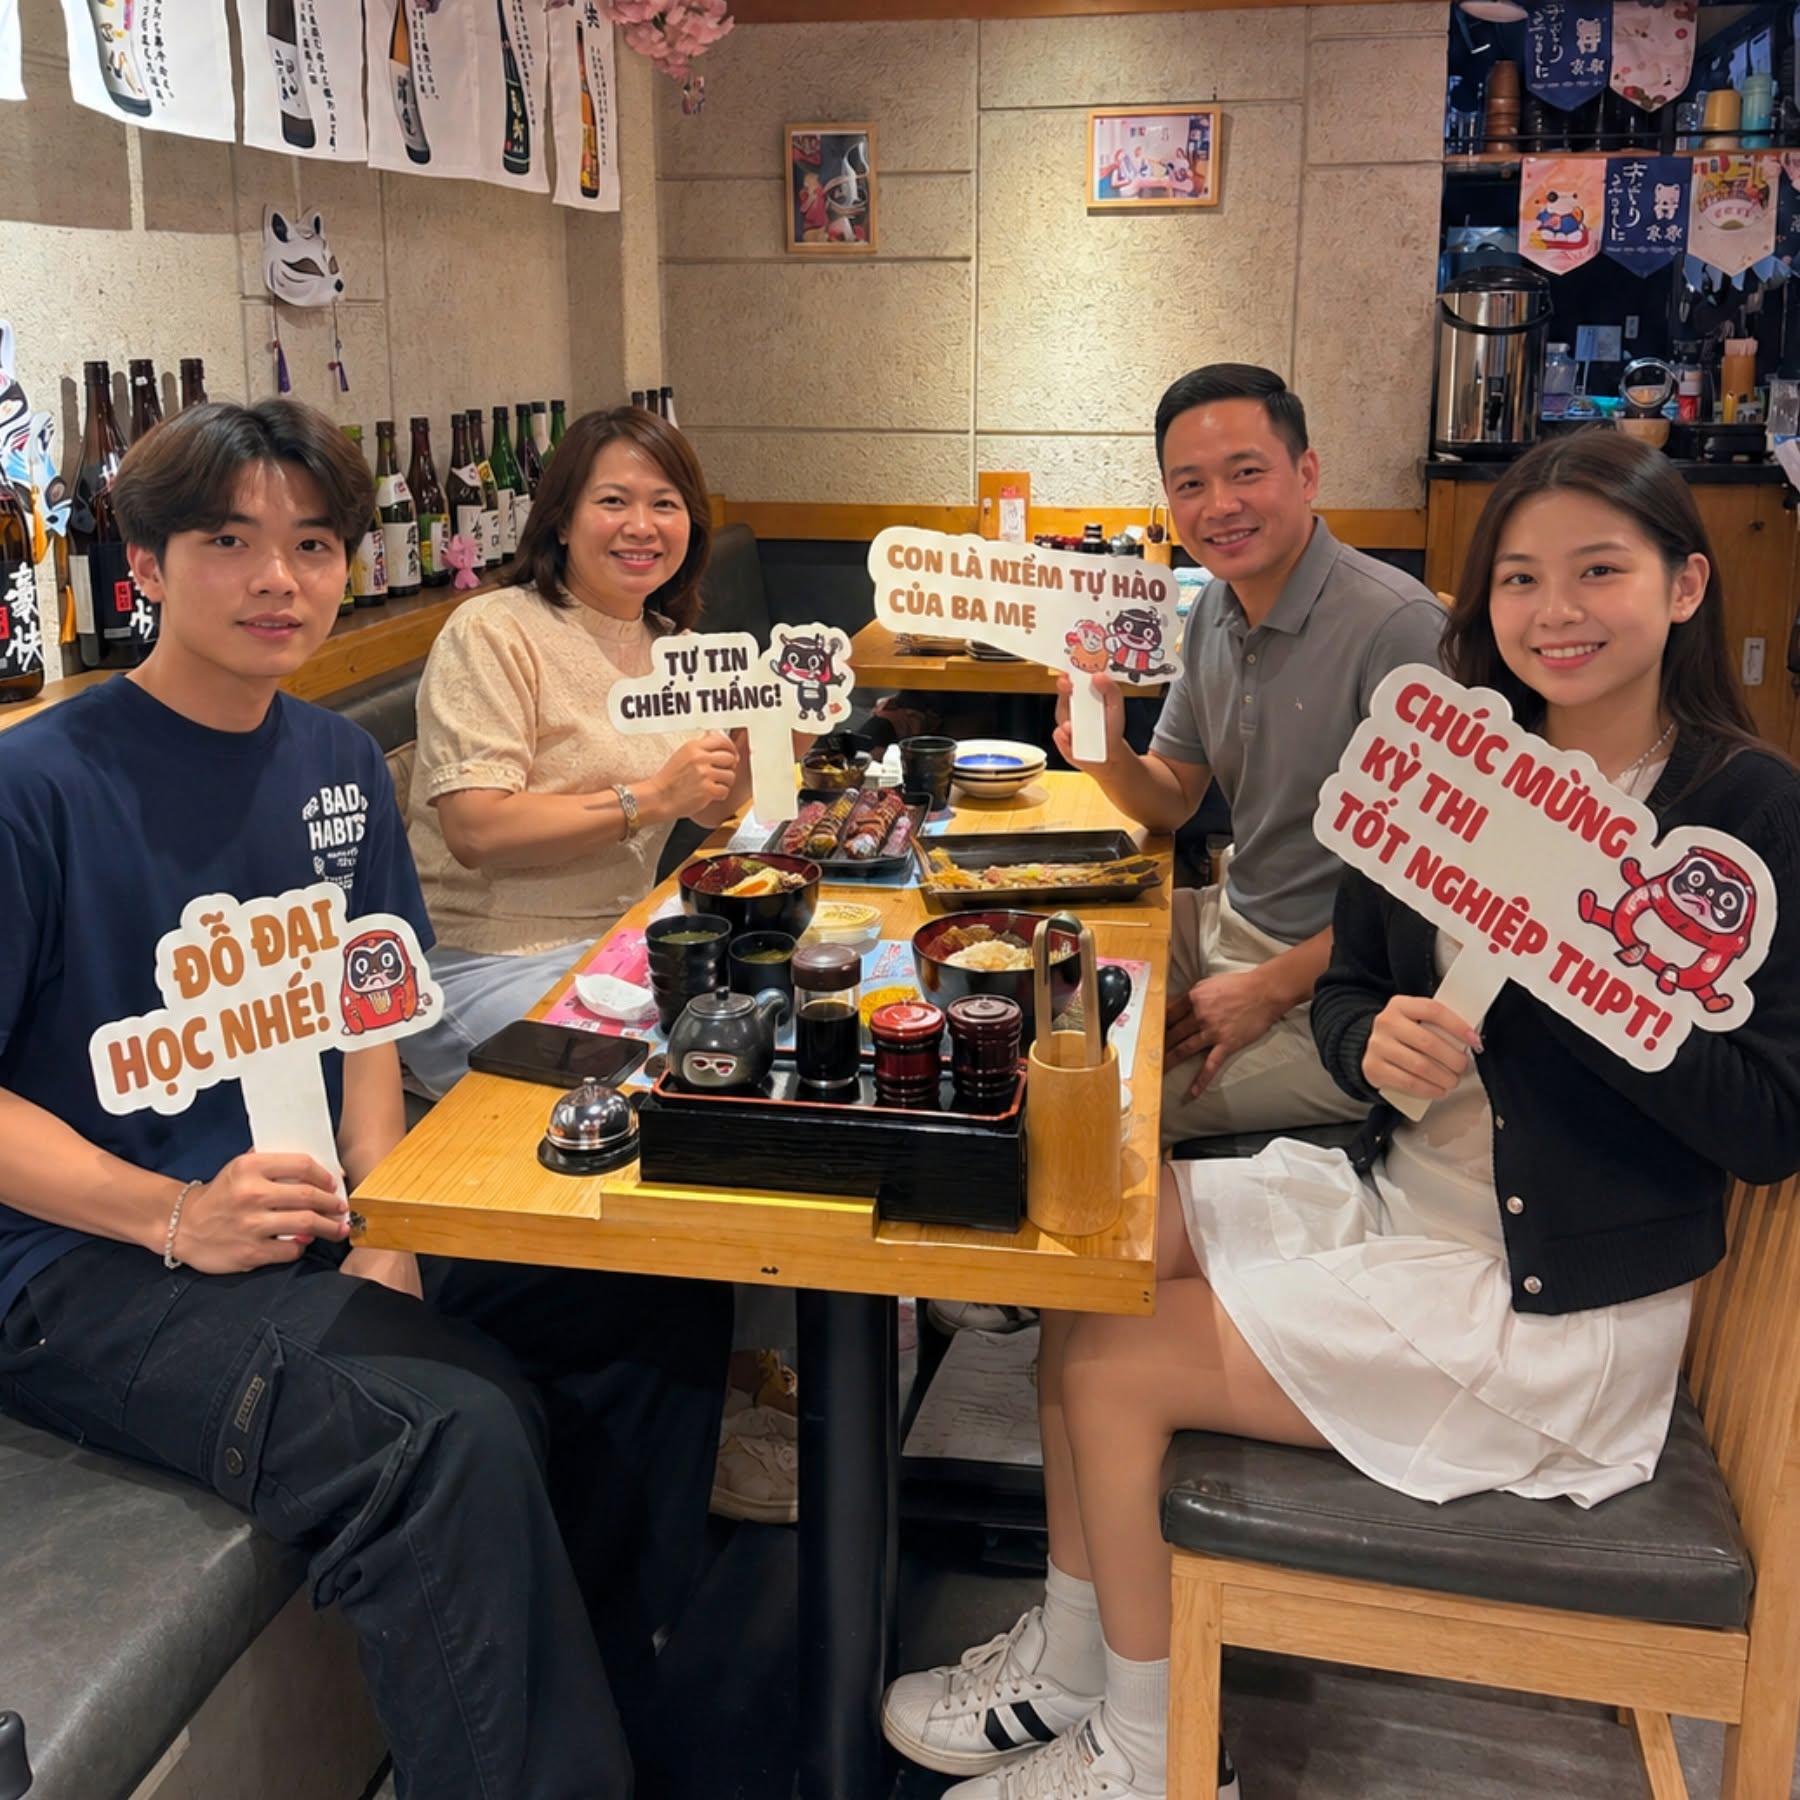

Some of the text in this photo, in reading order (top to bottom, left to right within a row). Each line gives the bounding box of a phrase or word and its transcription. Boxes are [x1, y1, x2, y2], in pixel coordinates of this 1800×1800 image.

[887, 544, 943, 574] CON
[950, 547, 982, 580] LÀ
[1070, 568, 1105, 601] TỰ
[1112, 569, 1167, 602] HÀO
[889, 582, 1037, 634] CỦA BA MẸ
[620, 680, 692, 720] CHIẾN
[664, 646, 748, 682] TỰ TIN
[320, 784, 359, 816] BAD
[1360, 736, 1489, 843] KỲ THI
[1395, 683, 1637, 859] CHÚC MỪNG
[173, 899, 339, 999] ĐỖ ĐẠI
[1333, 791, 1673, 1052] TỐT NGHIỆP THPT!
[107, 971, 330, 1096] HỌC NHÉ!
